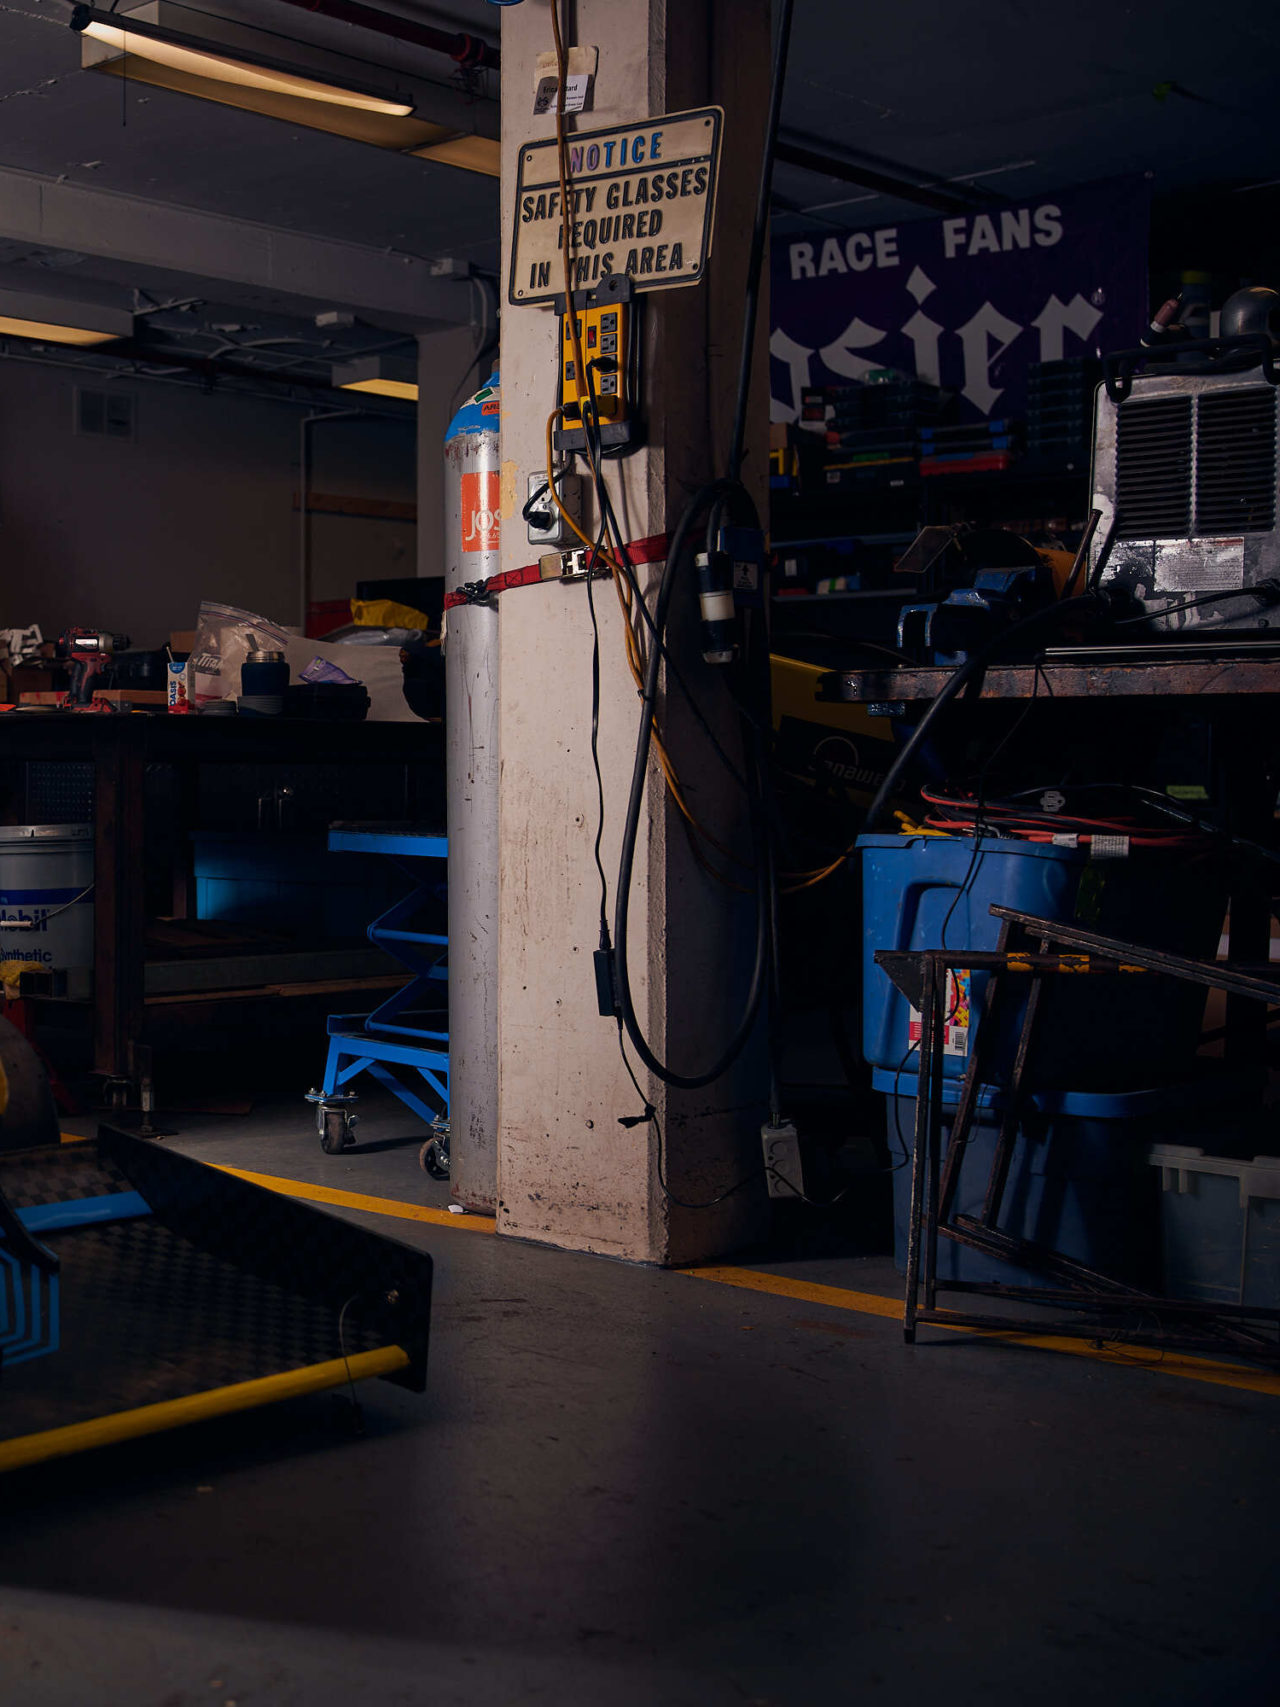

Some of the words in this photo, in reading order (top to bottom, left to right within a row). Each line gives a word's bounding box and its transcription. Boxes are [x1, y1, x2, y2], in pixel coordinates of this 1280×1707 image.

[570, 132, 663, 173] NOTICE
[606, 167, 708, 210] GLASSES
[789, 229, 901, 281] RACE
[942, 204, 1064, 259] FANS
[530, 261, 551, 289] IN
[624, 242, 683, 276] AREA
[169, 680, 177, 706] OASIS
